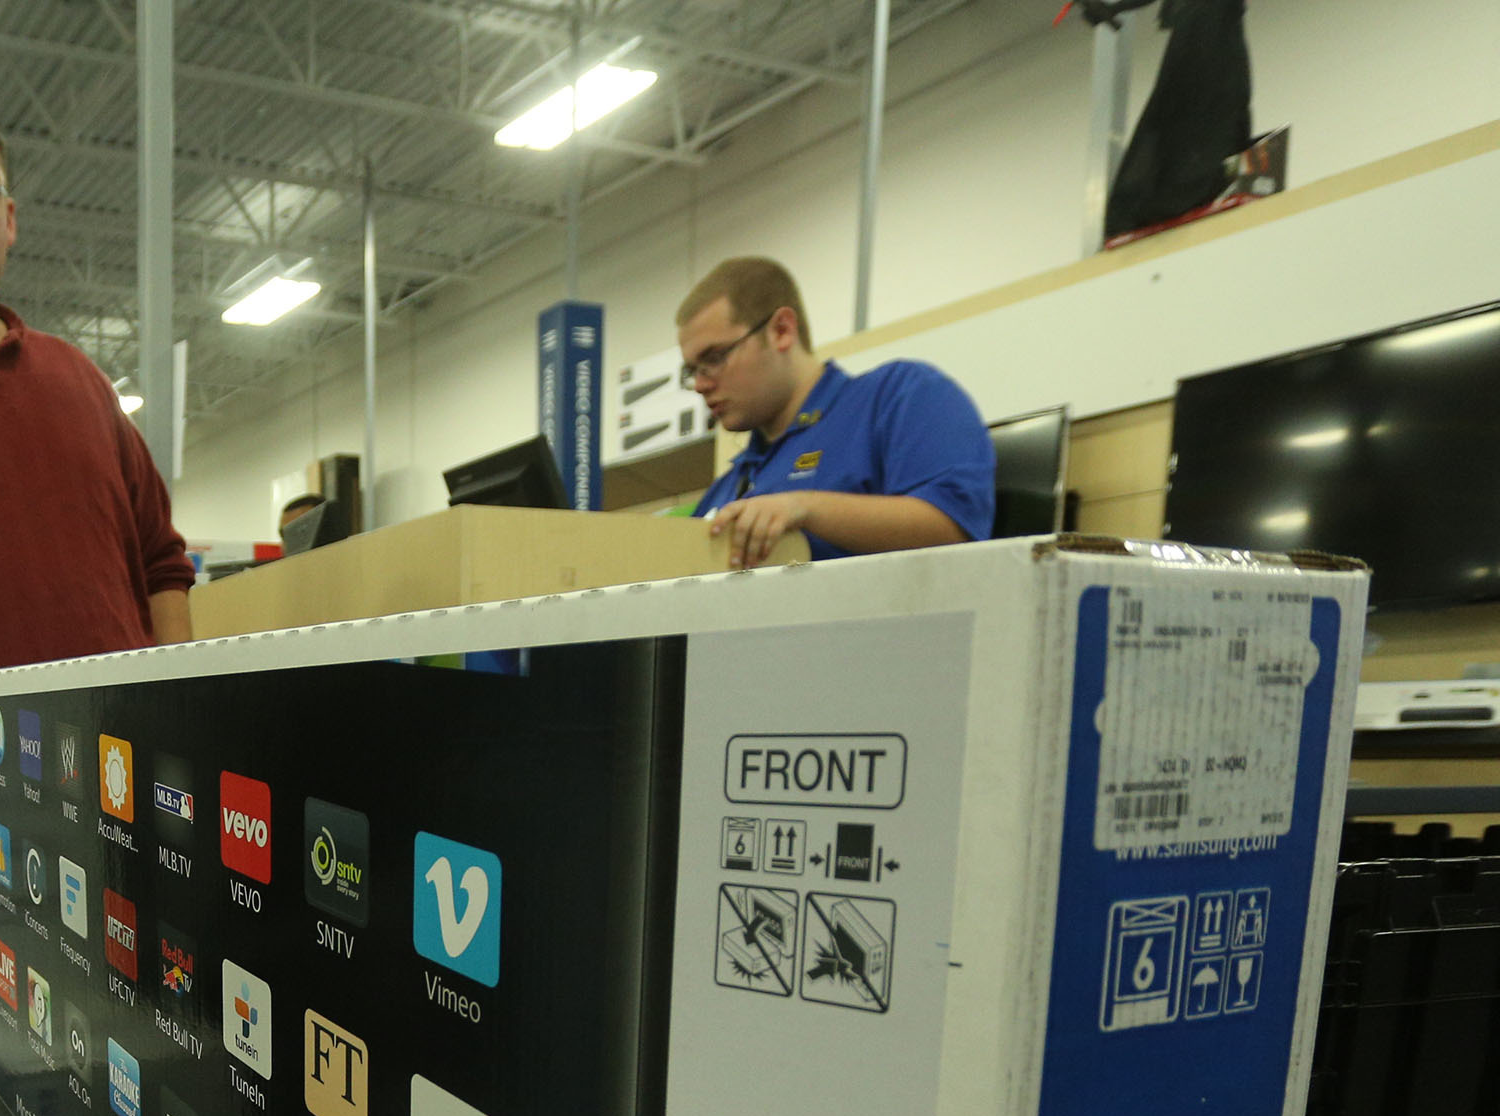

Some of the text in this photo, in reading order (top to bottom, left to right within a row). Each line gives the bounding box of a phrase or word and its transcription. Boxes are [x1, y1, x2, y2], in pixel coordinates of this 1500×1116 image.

[576, 360, 591, 413] VIDEO
[740, 748, 887, 792] FRONT
[223, 807, 268, 848] vevo
[1114, 832, 1278, 861] www.samsung.com
[158, 845, 192, 878] MLB.TV
[336, 861, 362, 884] sntv
[838, 856, 869, 869] FRONT
[230, 879, 262, 913] VEVO
[60, 936, 91, 977] Frequency
[317, 920, 354, 959] SNTV
[425, 970, 481, 1024] Vimeo
[155, 1008, 203, 1060] Red Bull TV
[235, 1033, 258, 1062] tunein
[310, 1020, 363, 1107] FT
[109, 1061, 140, 1109] KARAOKE
